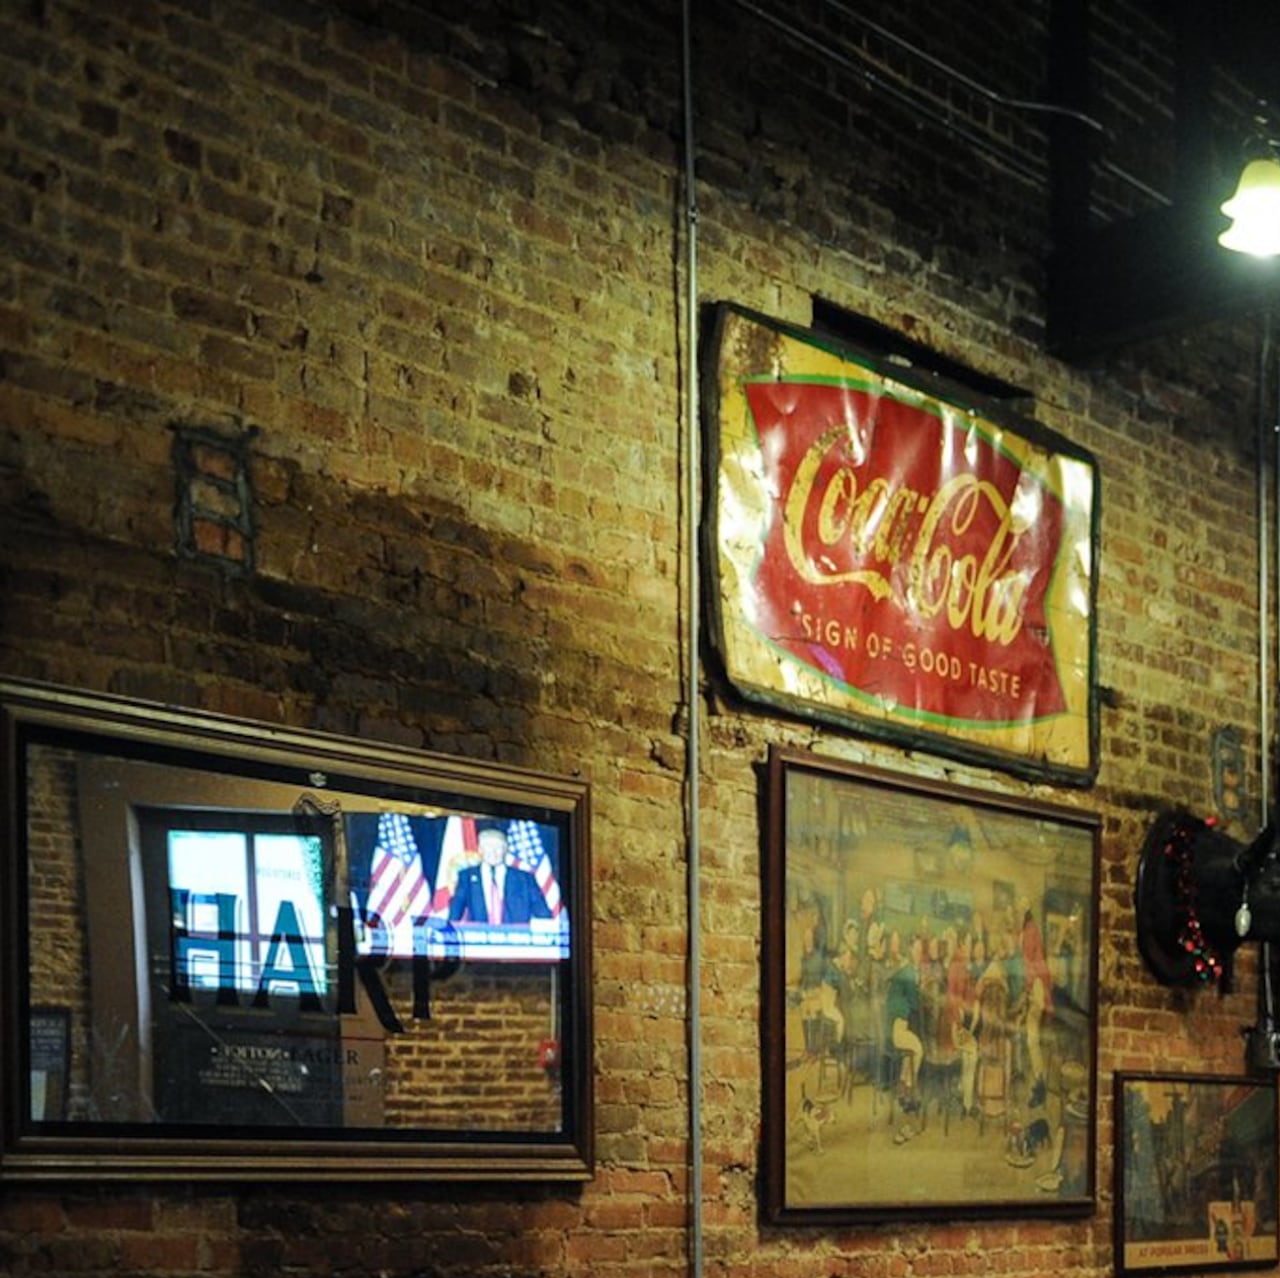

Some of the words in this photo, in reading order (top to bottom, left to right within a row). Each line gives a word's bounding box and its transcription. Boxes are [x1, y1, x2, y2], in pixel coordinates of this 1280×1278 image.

[784, 423, 1038, 647] Coca-Cola
[802, 613, 858, 651] SIGN
[866, 632, 893, 660] OF
[903, 641, 962, 681] GOOD
[968, 662, 1022, 700] TASTE
